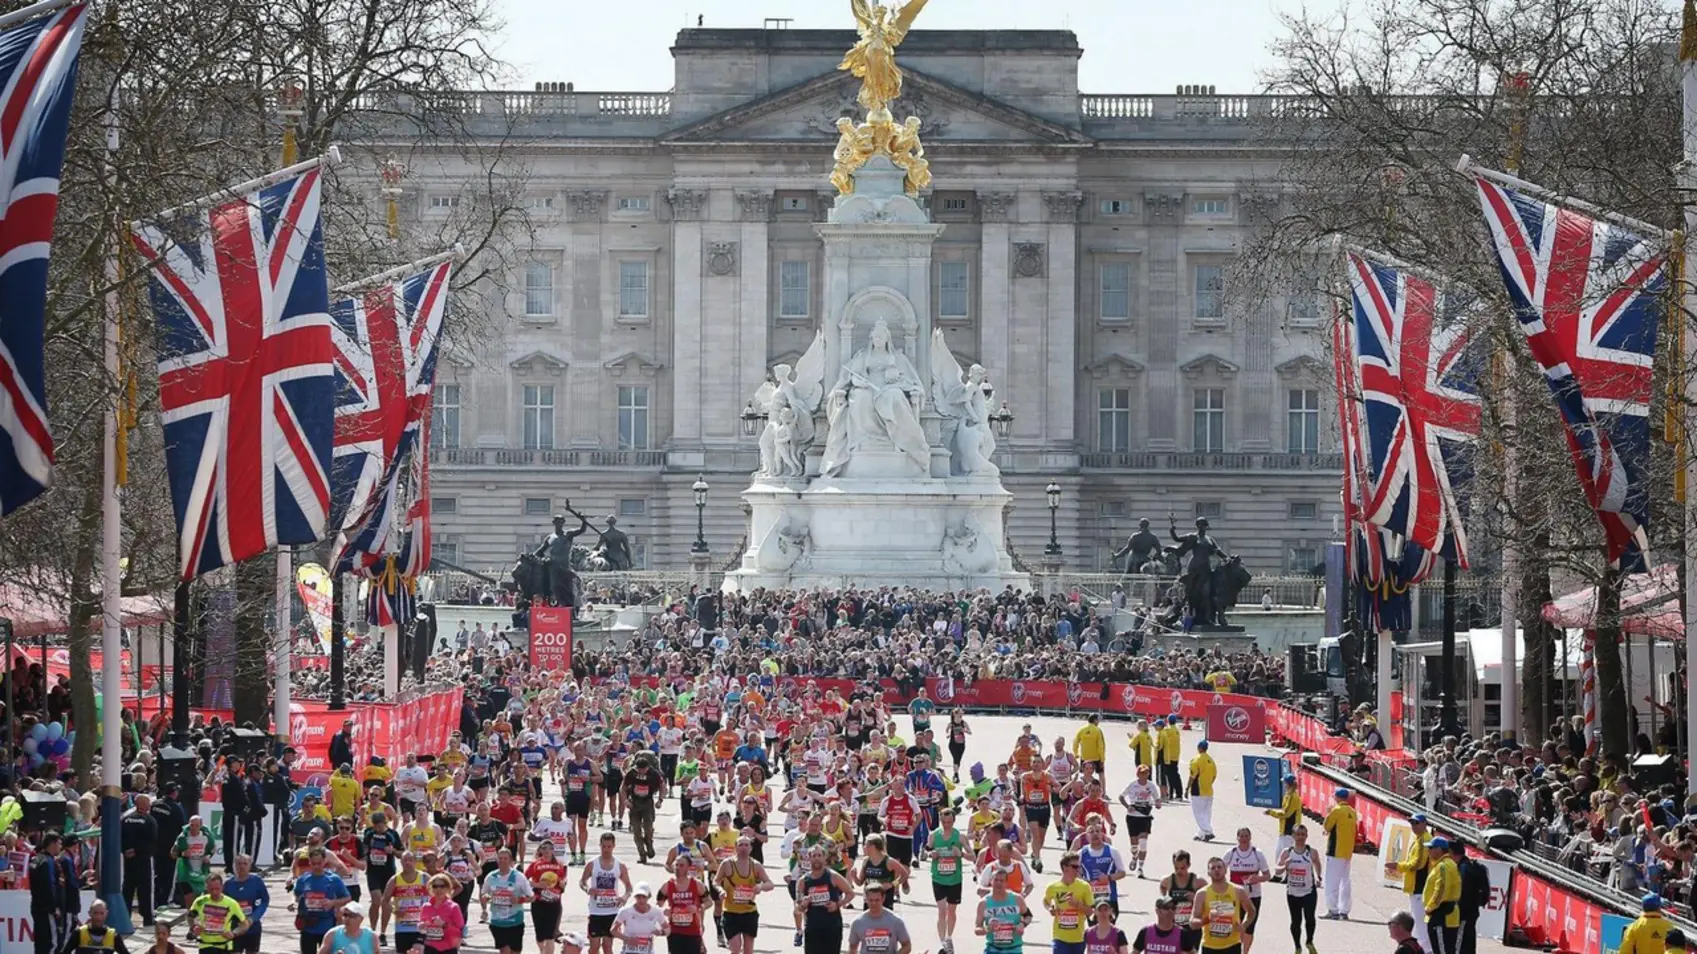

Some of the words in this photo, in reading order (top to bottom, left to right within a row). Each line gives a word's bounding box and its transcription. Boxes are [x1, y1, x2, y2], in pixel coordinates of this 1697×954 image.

[534, 632, 567, 646] 200
[535, 646, 566, 654] METRES
[1227, 710, 1247, 729] Virgin
[1224, 733, 1250, 742] money
[1146, 943, 1176, 953] ALISTAIR
